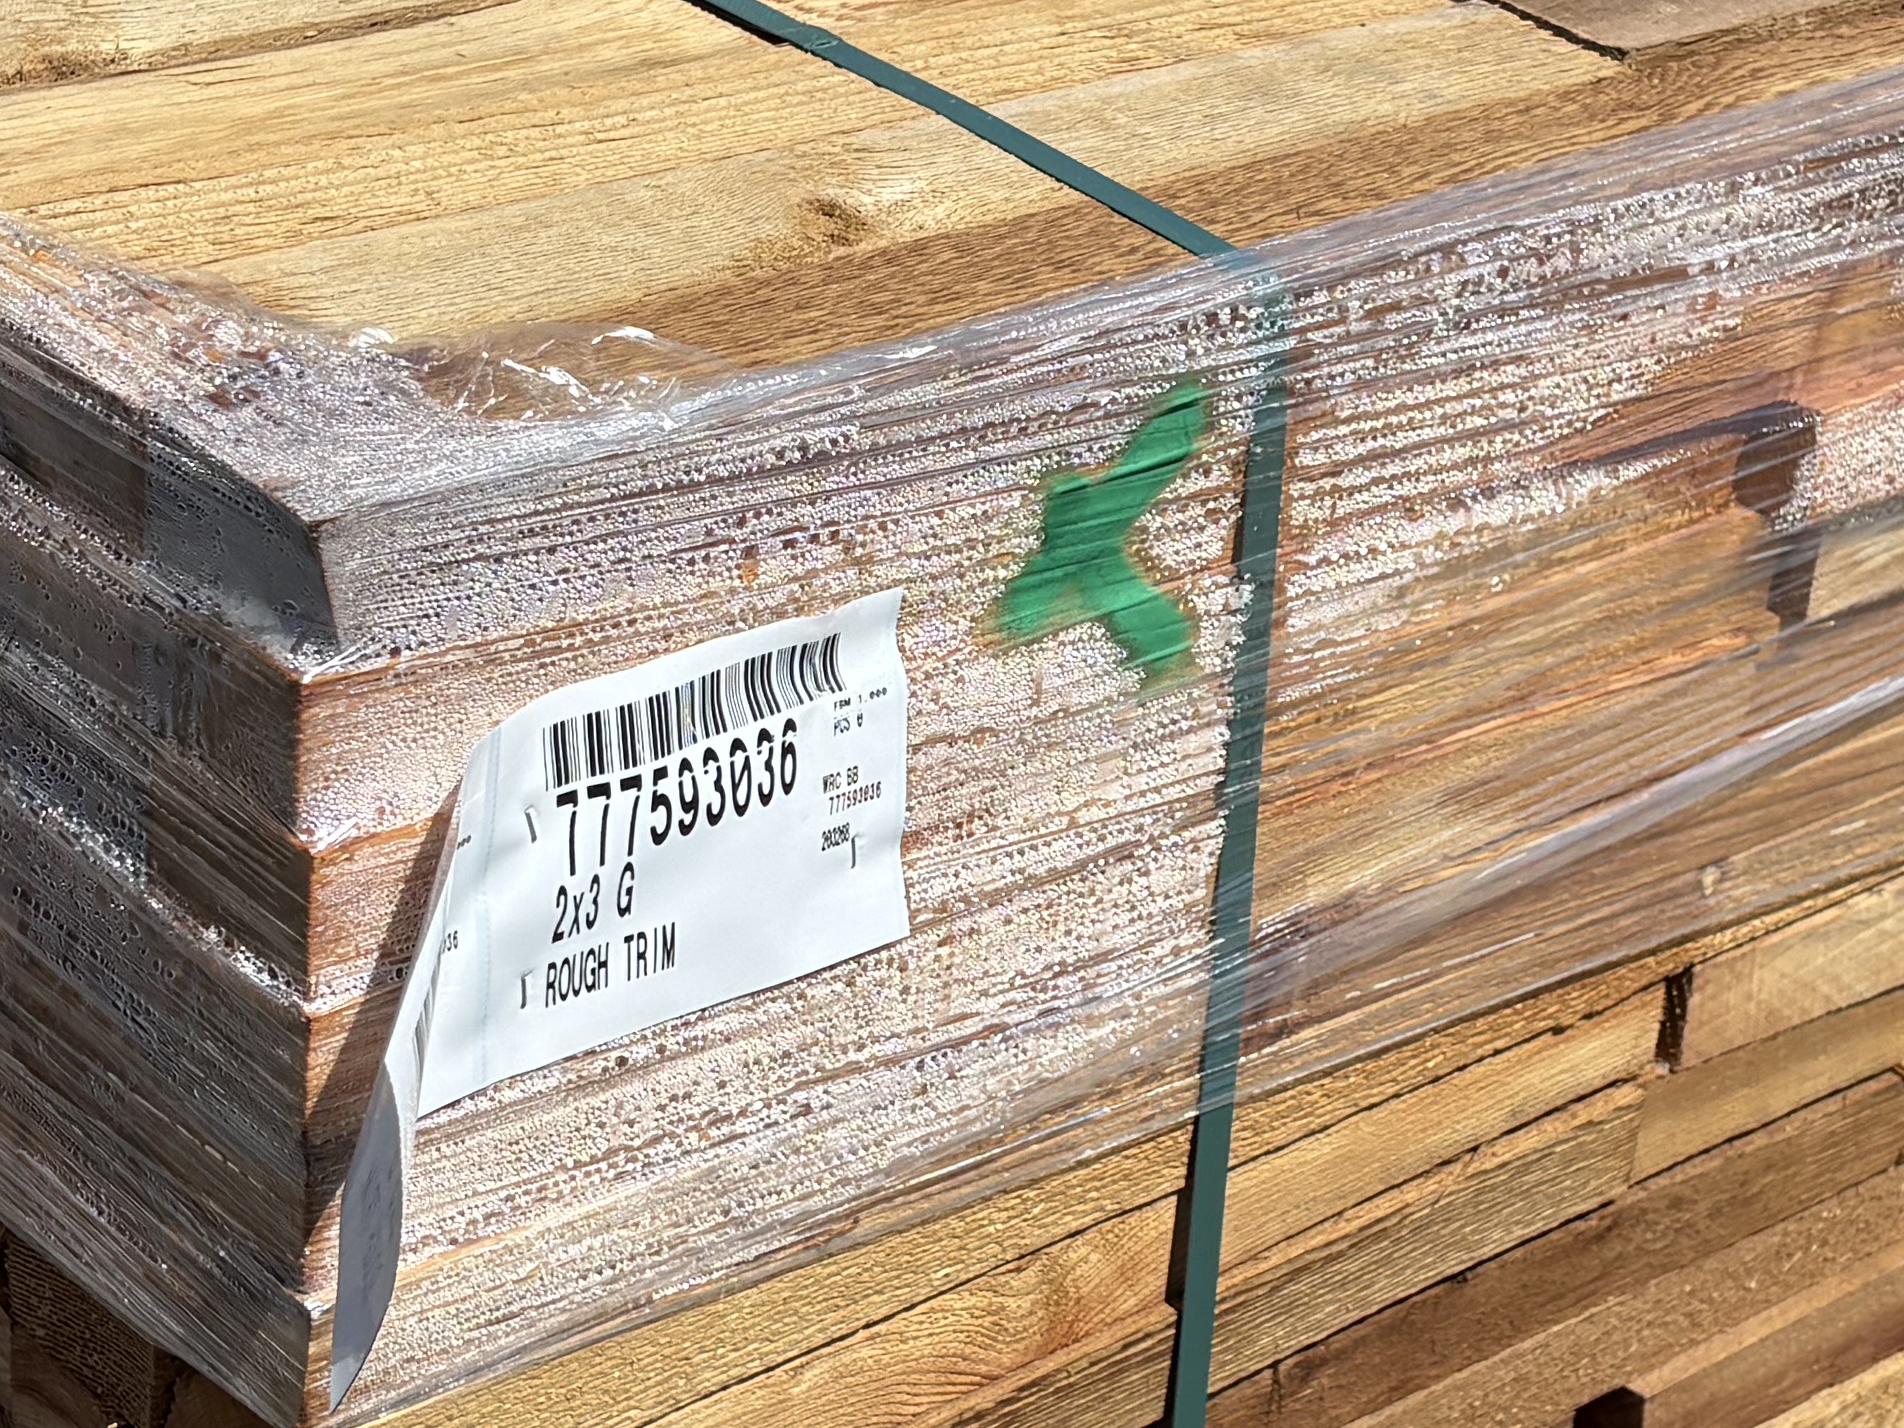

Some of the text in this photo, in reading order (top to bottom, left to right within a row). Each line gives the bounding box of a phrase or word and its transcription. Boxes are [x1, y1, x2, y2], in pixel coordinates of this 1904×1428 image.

[556, 717, 798, 877] 777593036
[828, 781, 882, 816] 777593036
[551, 861, 636, 945] 2x3 G
[545, 921, 677, 1009] ROUGH TRIM
